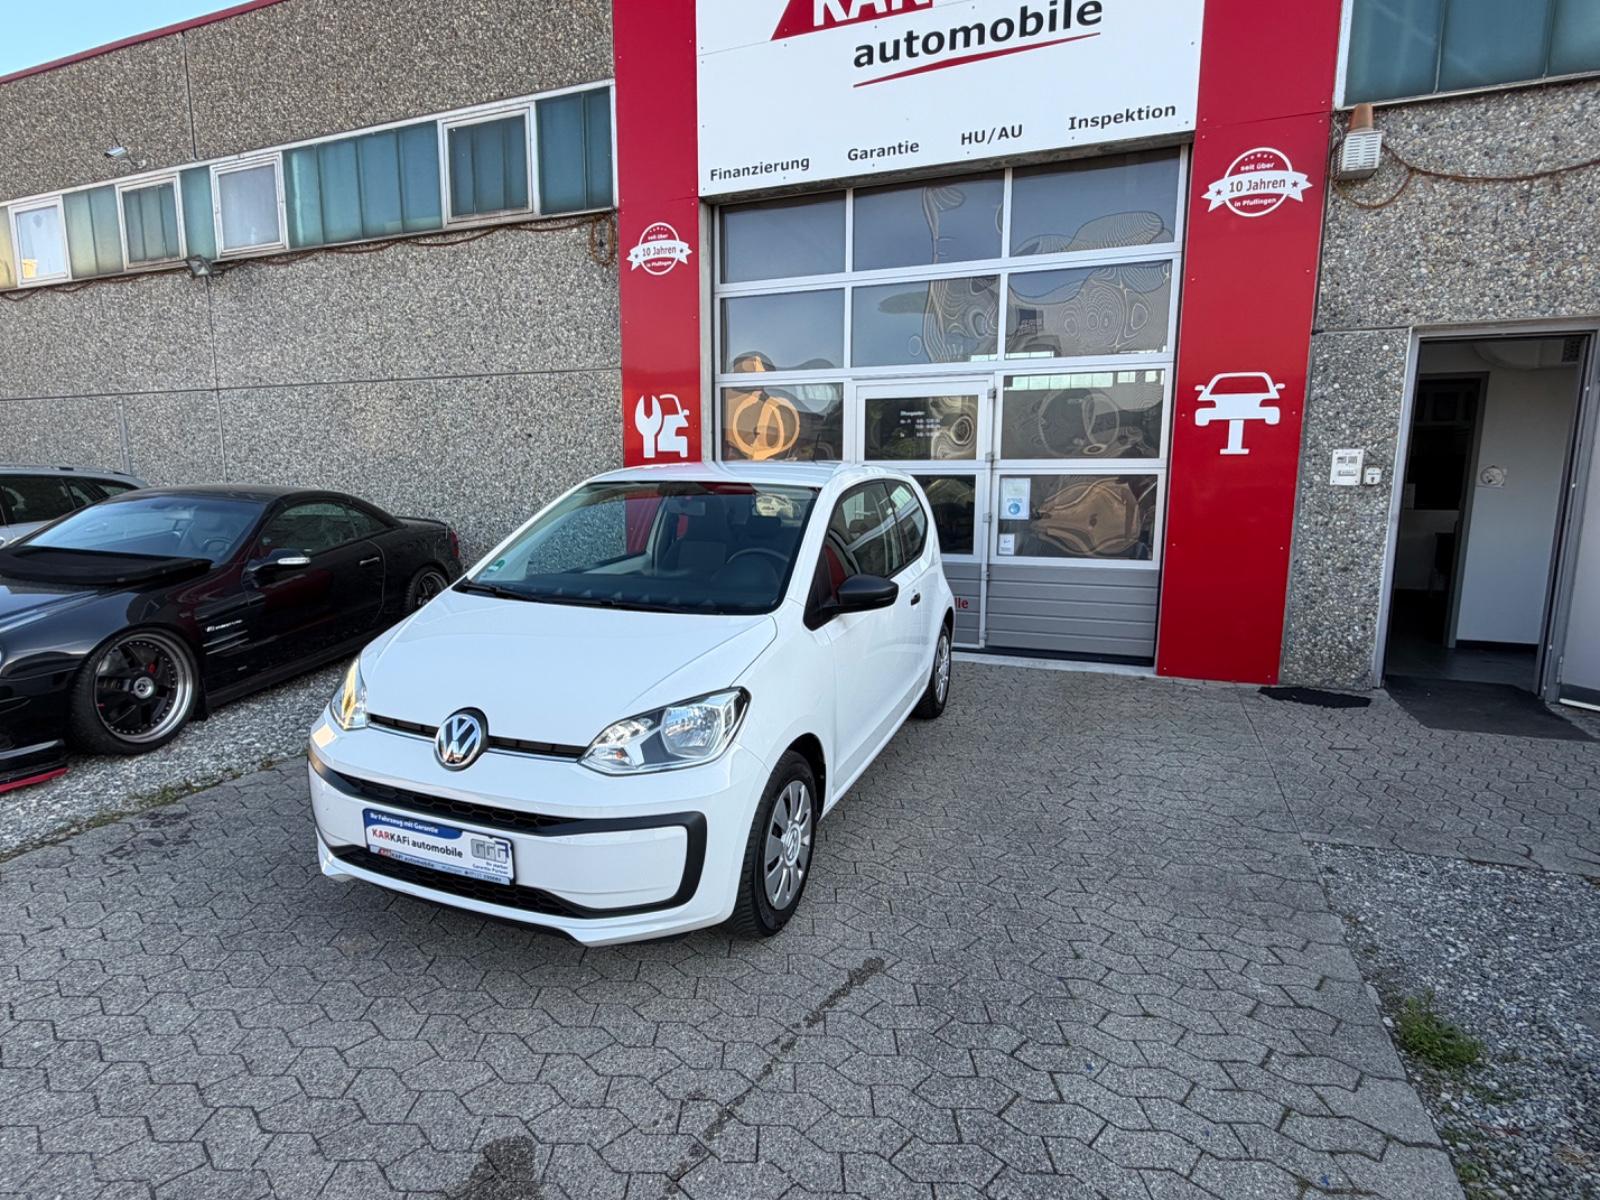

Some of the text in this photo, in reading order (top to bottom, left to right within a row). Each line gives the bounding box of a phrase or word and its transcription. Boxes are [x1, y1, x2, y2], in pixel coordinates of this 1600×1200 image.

[852, 0, 1103, 68] automobile
[709, 104, 1176, 181] Finanzierung Garantie HU/AU Inspektion
[1229, 178, 1286, 193] 10 Jahren
[642, 245, 677, 257] 10 Jahren
[411, 840, 463, 858] automobile
